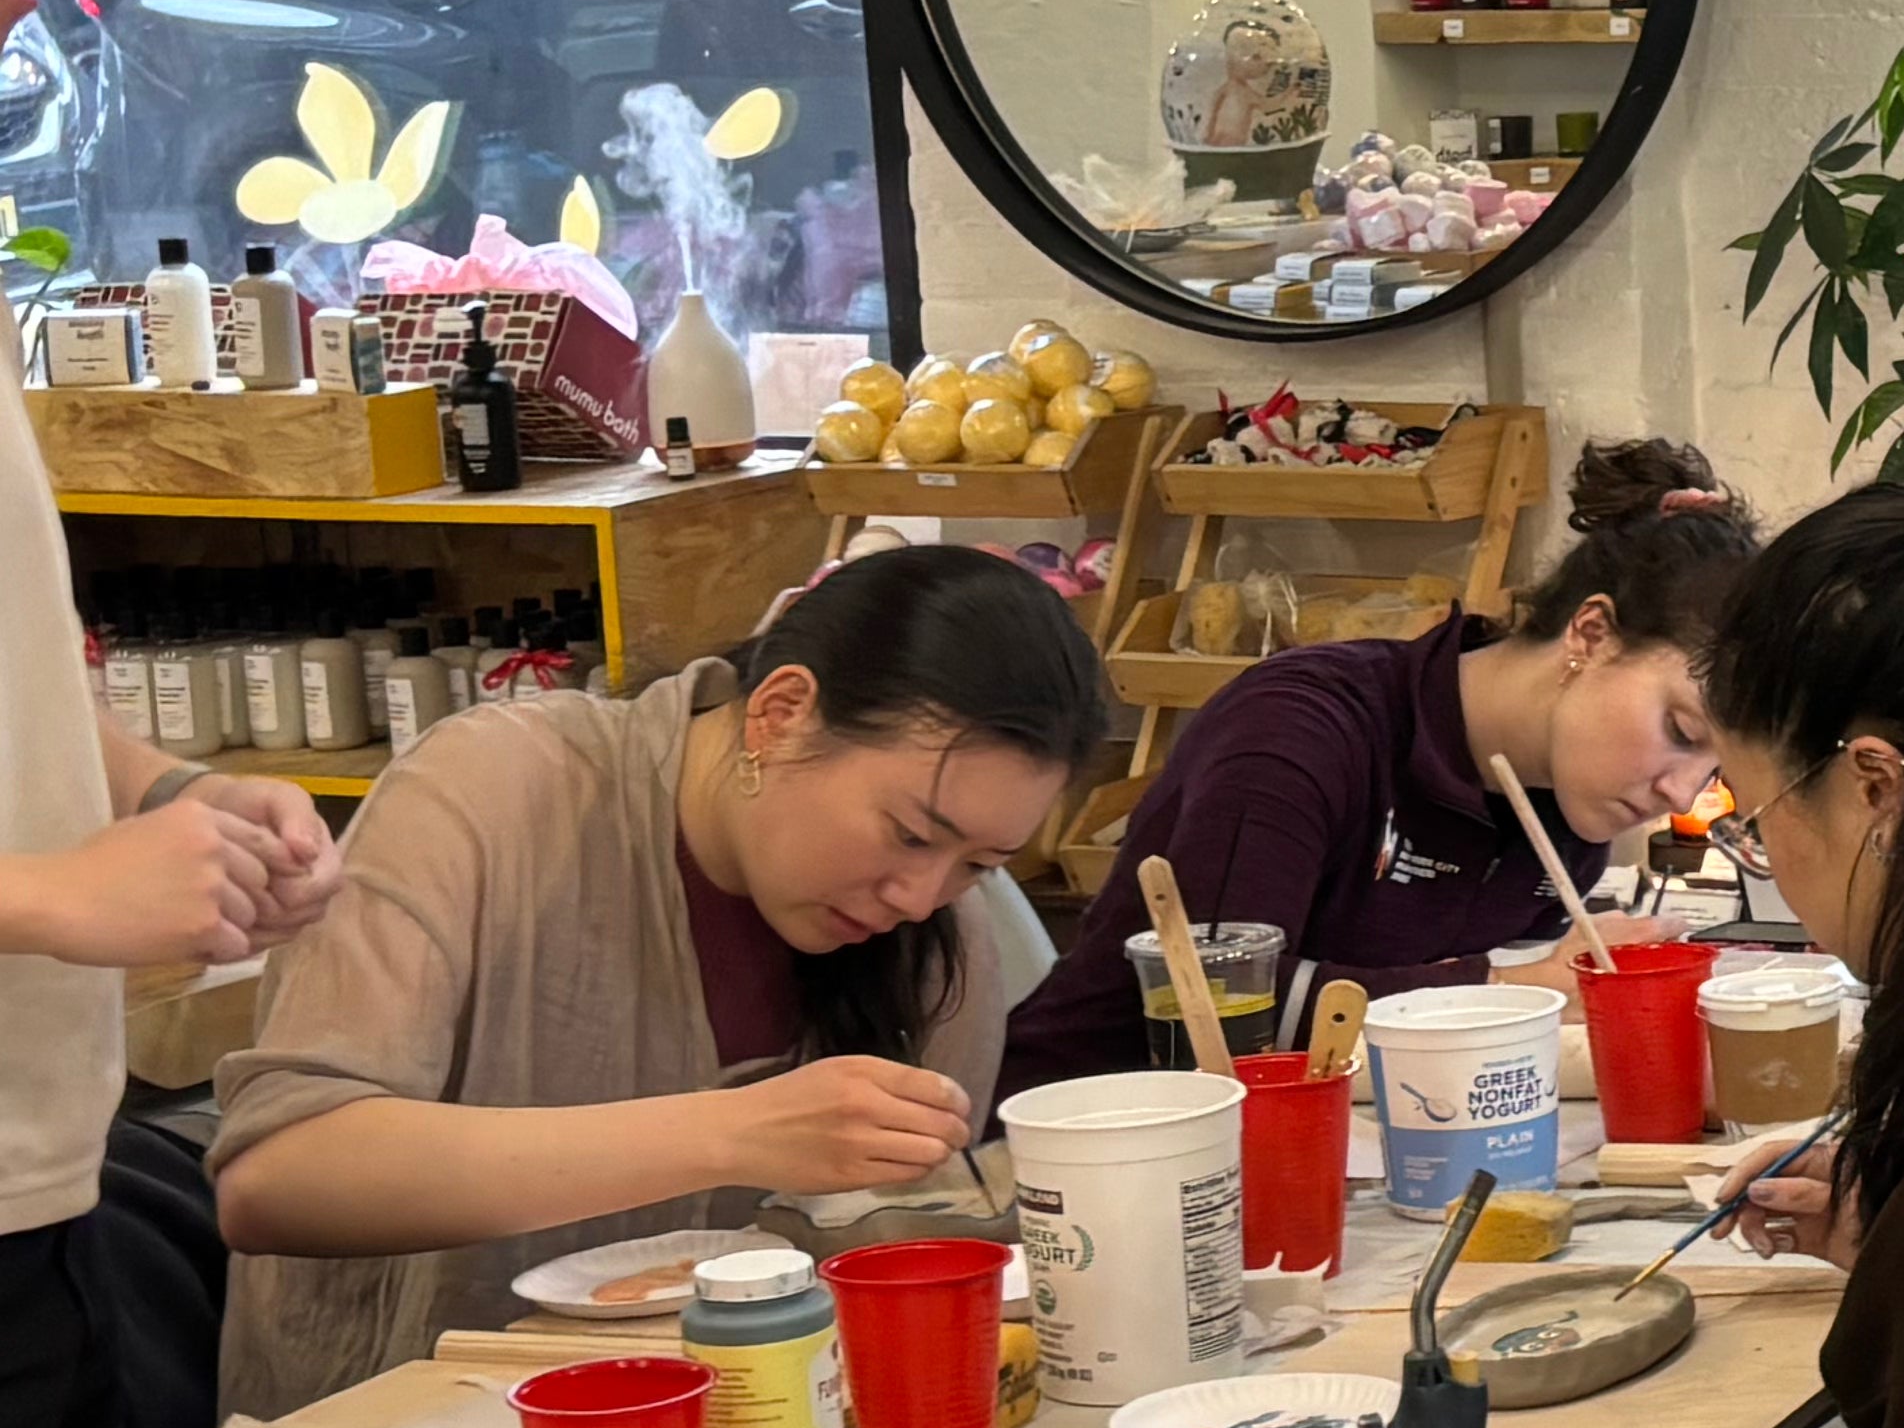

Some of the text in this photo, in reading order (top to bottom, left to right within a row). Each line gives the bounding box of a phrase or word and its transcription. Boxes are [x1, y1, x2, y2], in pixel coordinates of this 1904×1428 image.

[554, 375, 640, 445] mumu bath
[1473, 1065, 1537, 1089] GREEK
[1467, 1078, 1543, 1105] NONFAT
[1467, 1095, 1542, 1121] YOGURT
[1487, 1130, 1534, 1149] PLAIN
